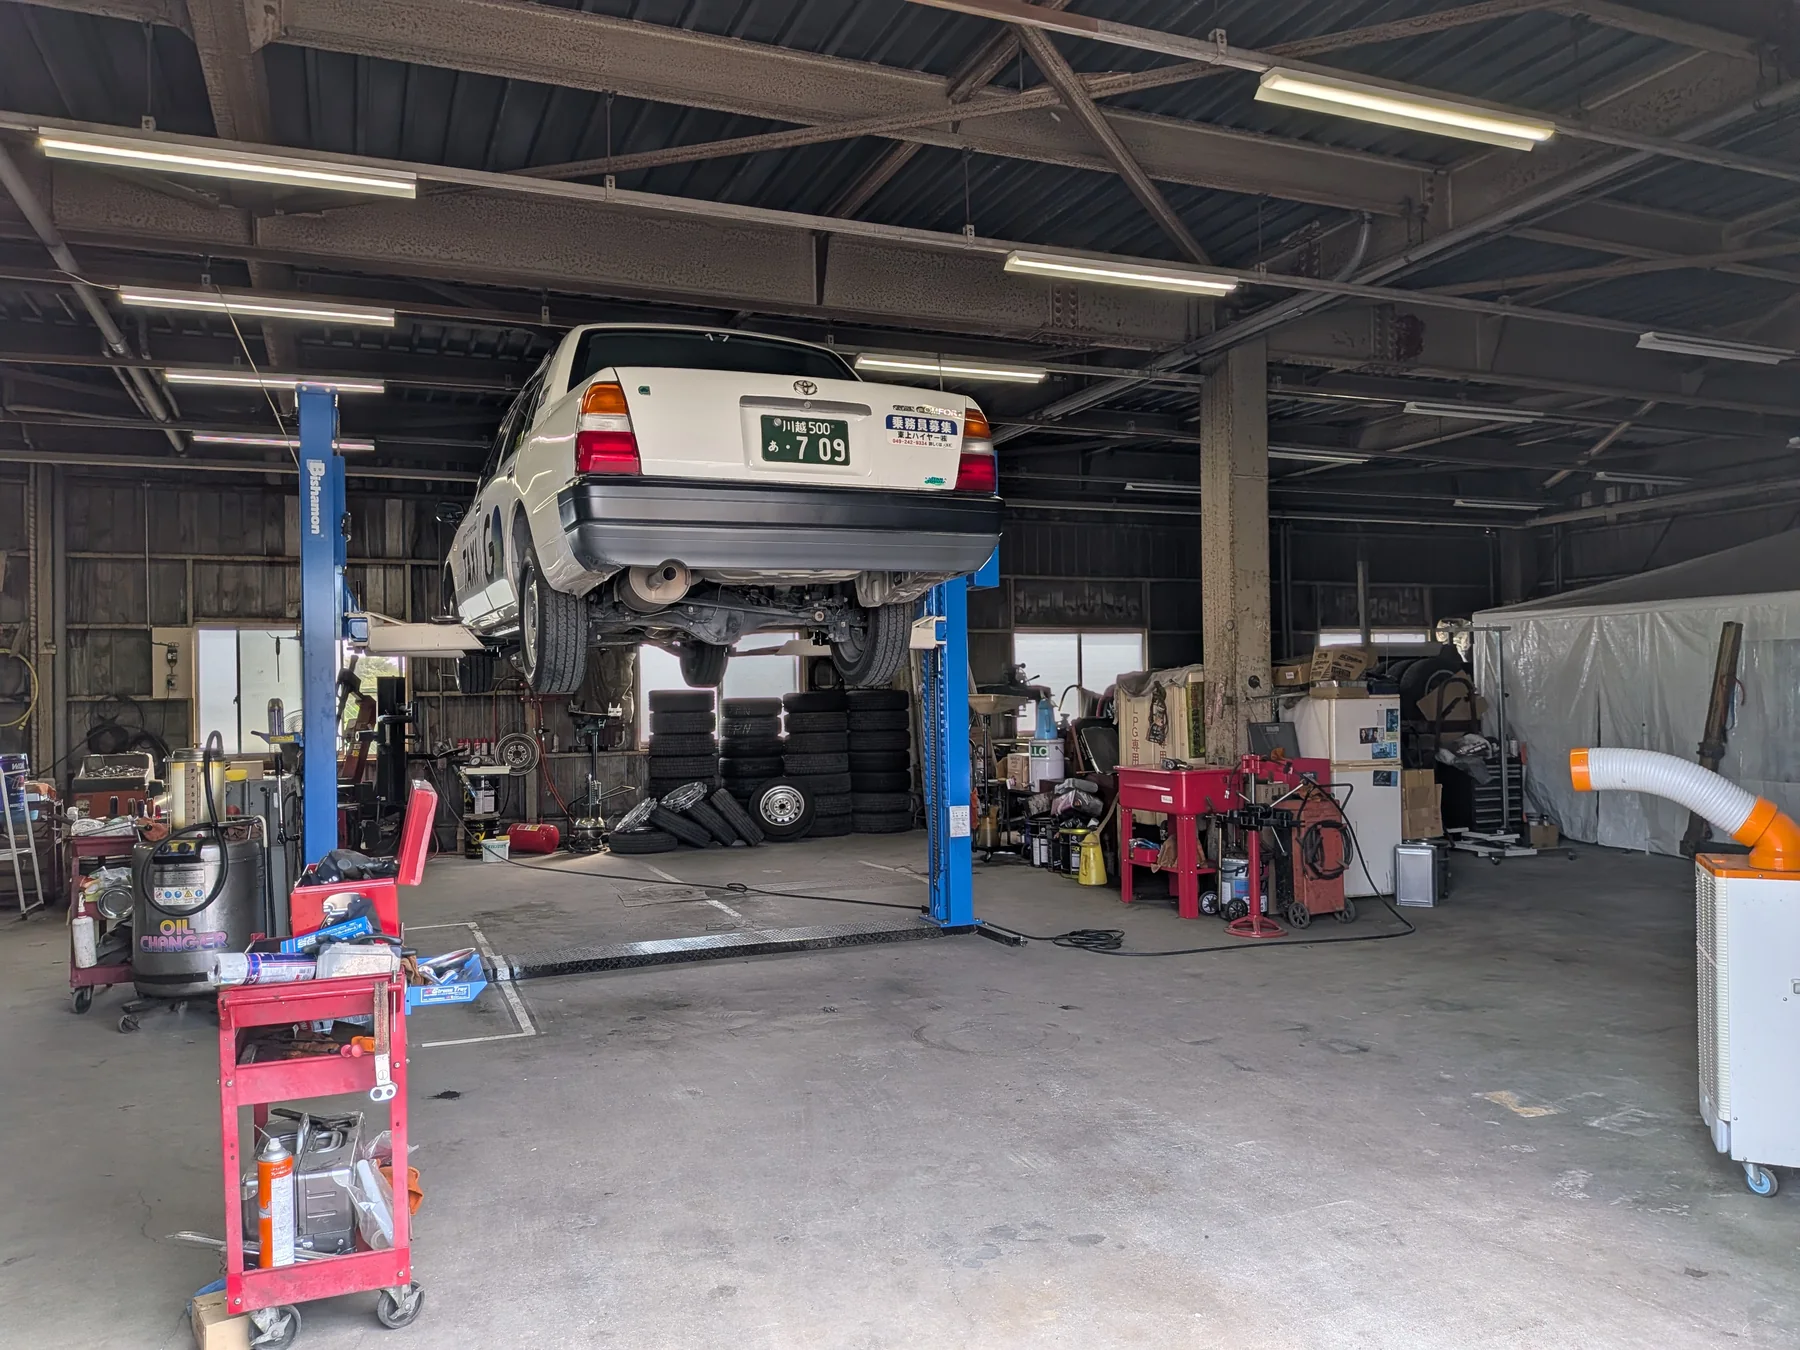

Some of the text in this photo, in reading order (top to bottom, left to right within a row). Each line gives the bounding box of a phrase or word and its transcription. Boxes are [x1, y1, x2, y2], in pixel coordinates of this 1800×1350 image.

[782, 420, 831, 435] 川越 500
[892, 416, 952, 434] 乗務員募集
[768, 440, 779, 453] あ
[306, 459, 326, 535] Bishamon
[159, 918, 195, 937] OIL
[140, 931, 228, 953] CHANGER
